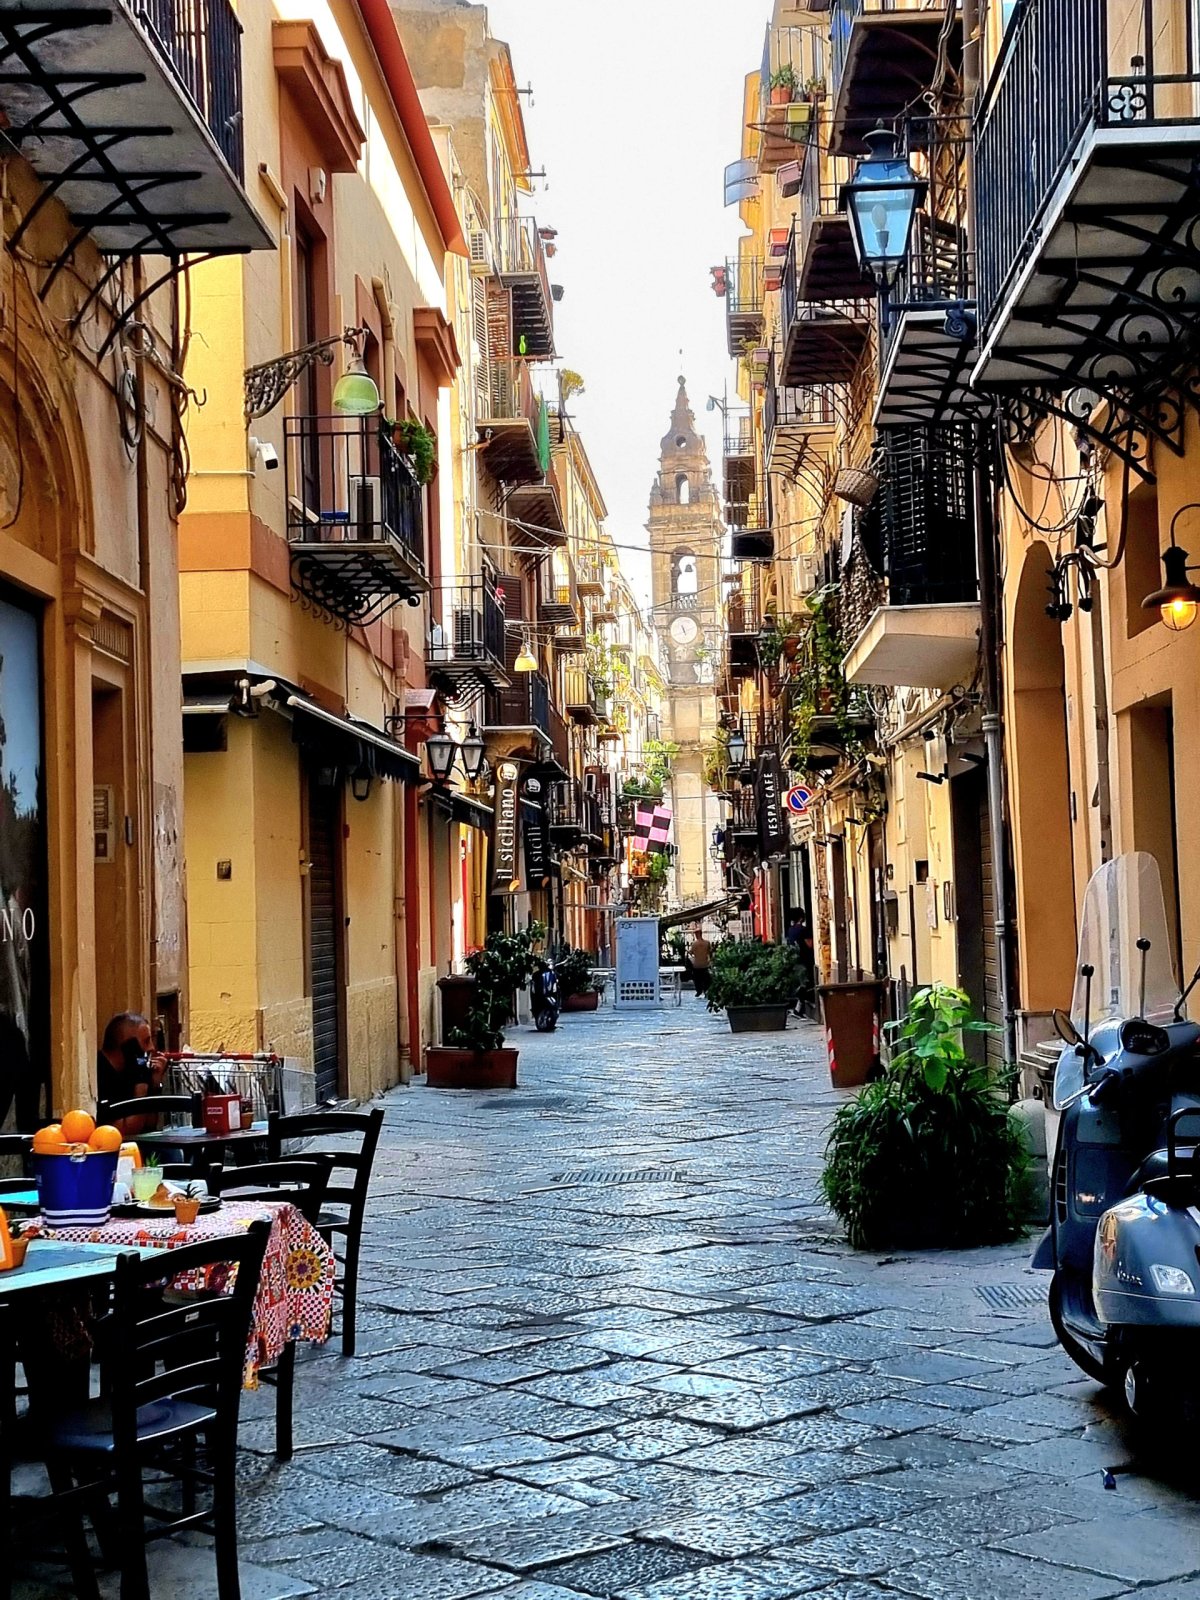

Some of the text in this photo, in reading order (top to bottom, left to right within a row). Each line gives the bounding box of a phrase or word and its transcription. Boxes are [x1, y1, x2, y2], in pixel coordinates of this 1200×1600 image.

[496, 788, 515, 880] il siciliano
[763, 772, 778, 837] VESPA CAFE
[529, 868, 544, 878] il
